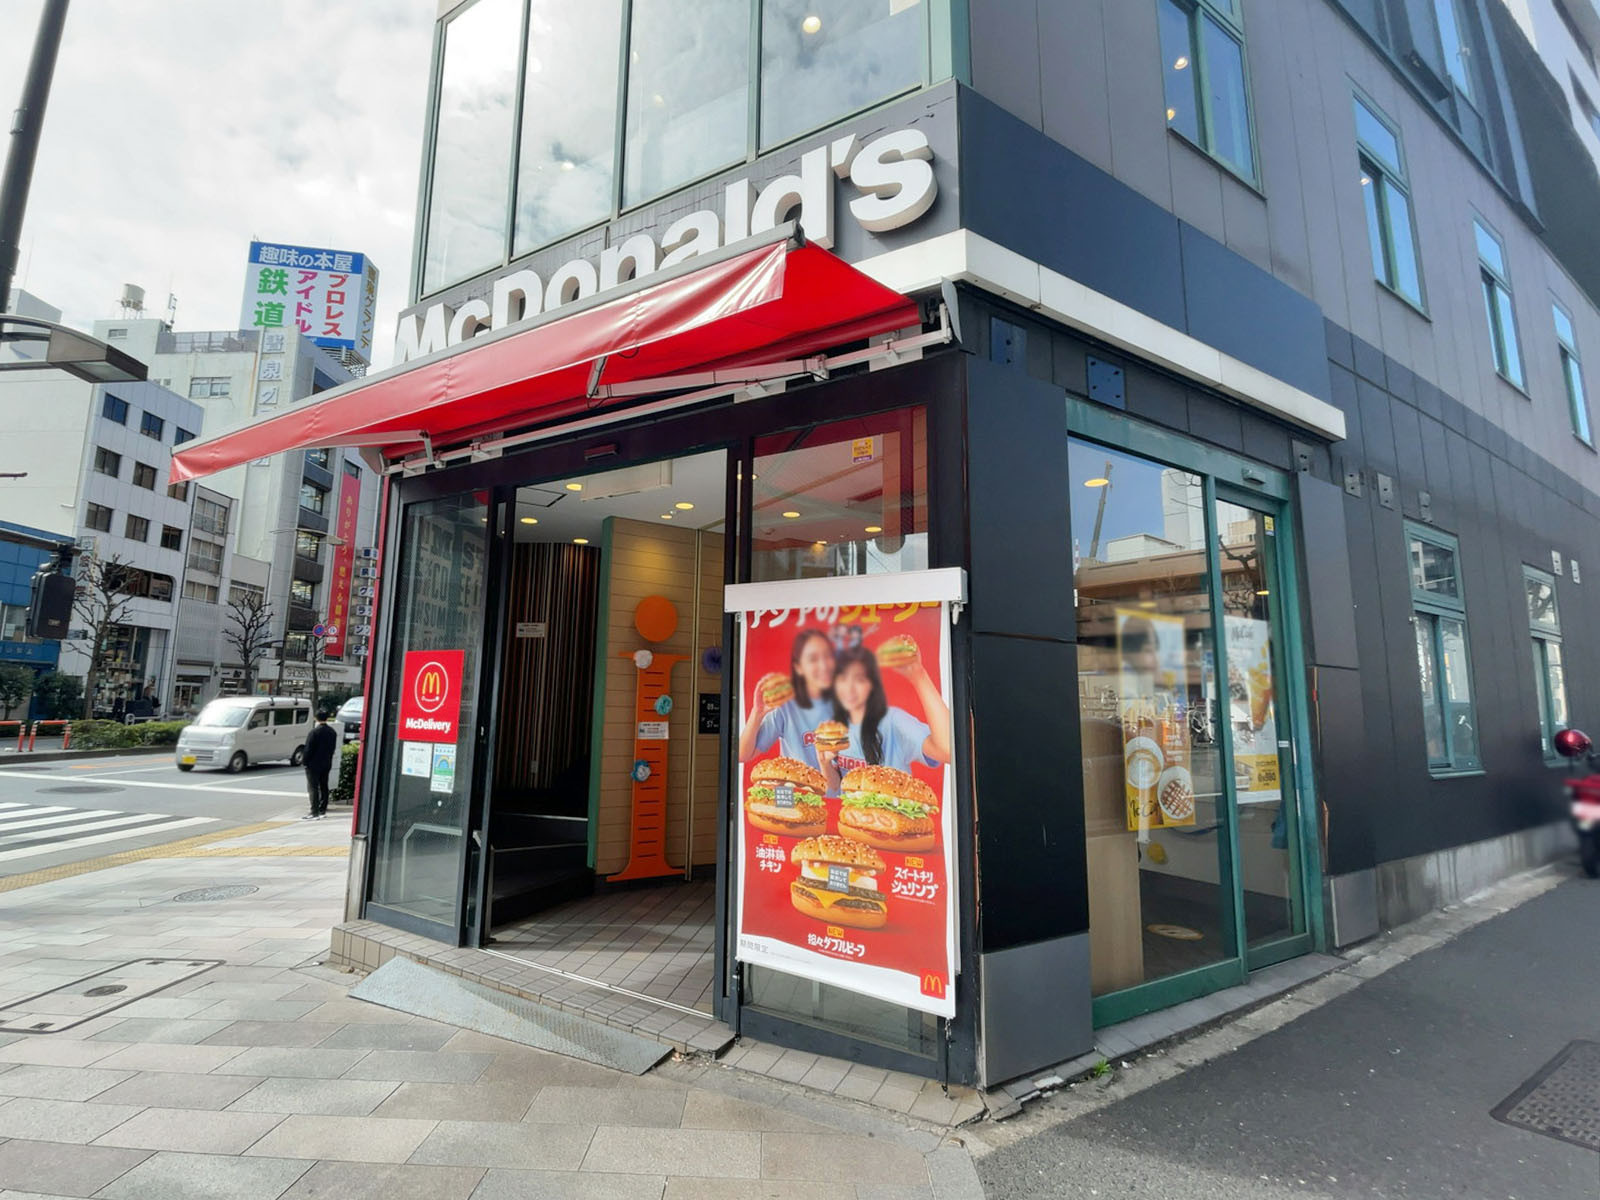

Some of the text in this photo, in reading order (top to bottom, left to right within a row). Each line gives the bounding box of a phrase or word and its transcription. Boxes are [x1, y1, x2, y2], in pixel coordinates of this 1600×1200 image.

[395, 128, 938, 366] McDonald's
[258, 245, 353, 272] 趣味の本屋
[253, 267, 289, 328] 鉄道
[295, 270, 318, 334] アイドル
[322, 273, 349, 337] プロレス
[405, 717, 451, 734] McDelivery
[759, 859, 782, 873] チキン
[906, 857, 923, 867] NEW
[894, 866, 934, 883] スイートチリ
[890, 879, 940, 899] シュリンプ
[828, 927, 843, 937] NEW
